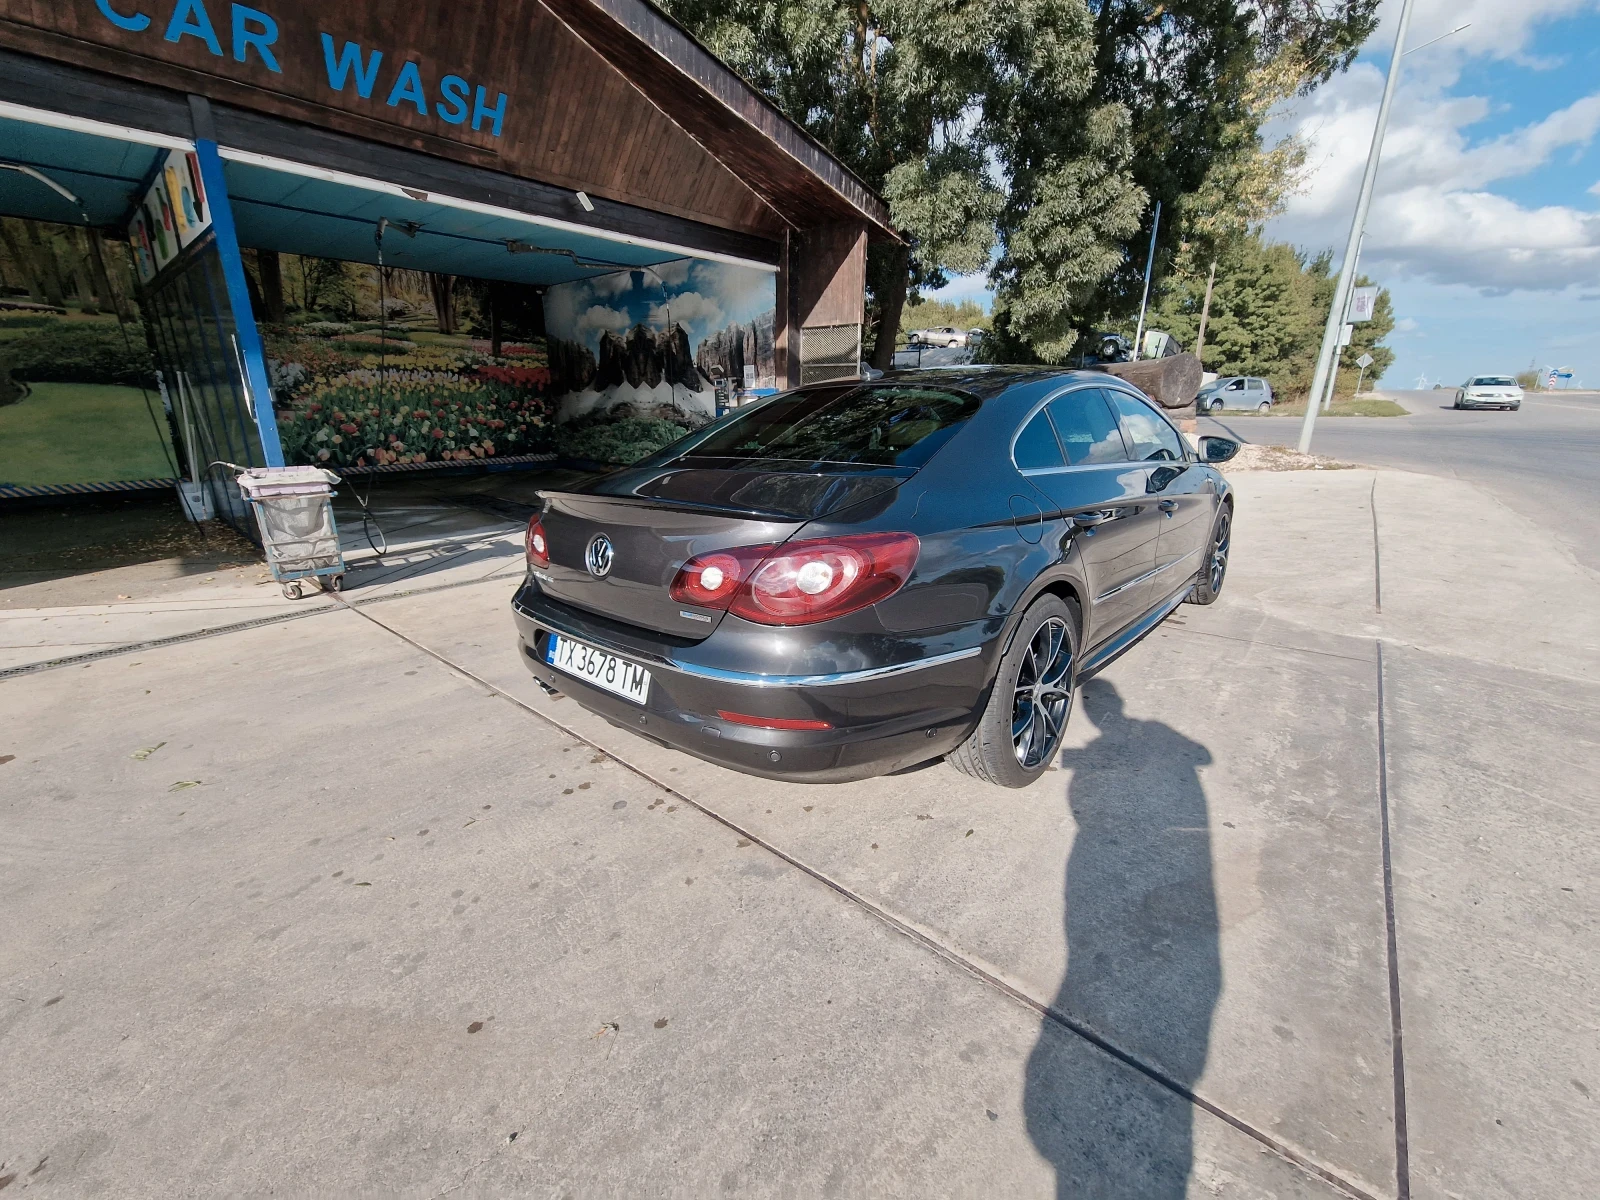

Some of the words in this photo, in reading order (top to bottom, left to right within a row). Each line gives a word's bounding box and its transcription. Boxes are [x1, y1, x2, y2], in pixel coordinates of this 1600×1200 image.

[320, 32, 508, 137] WASH
[577, 646, 617, 684] 3678
[621, 660, 646, 696] TM
